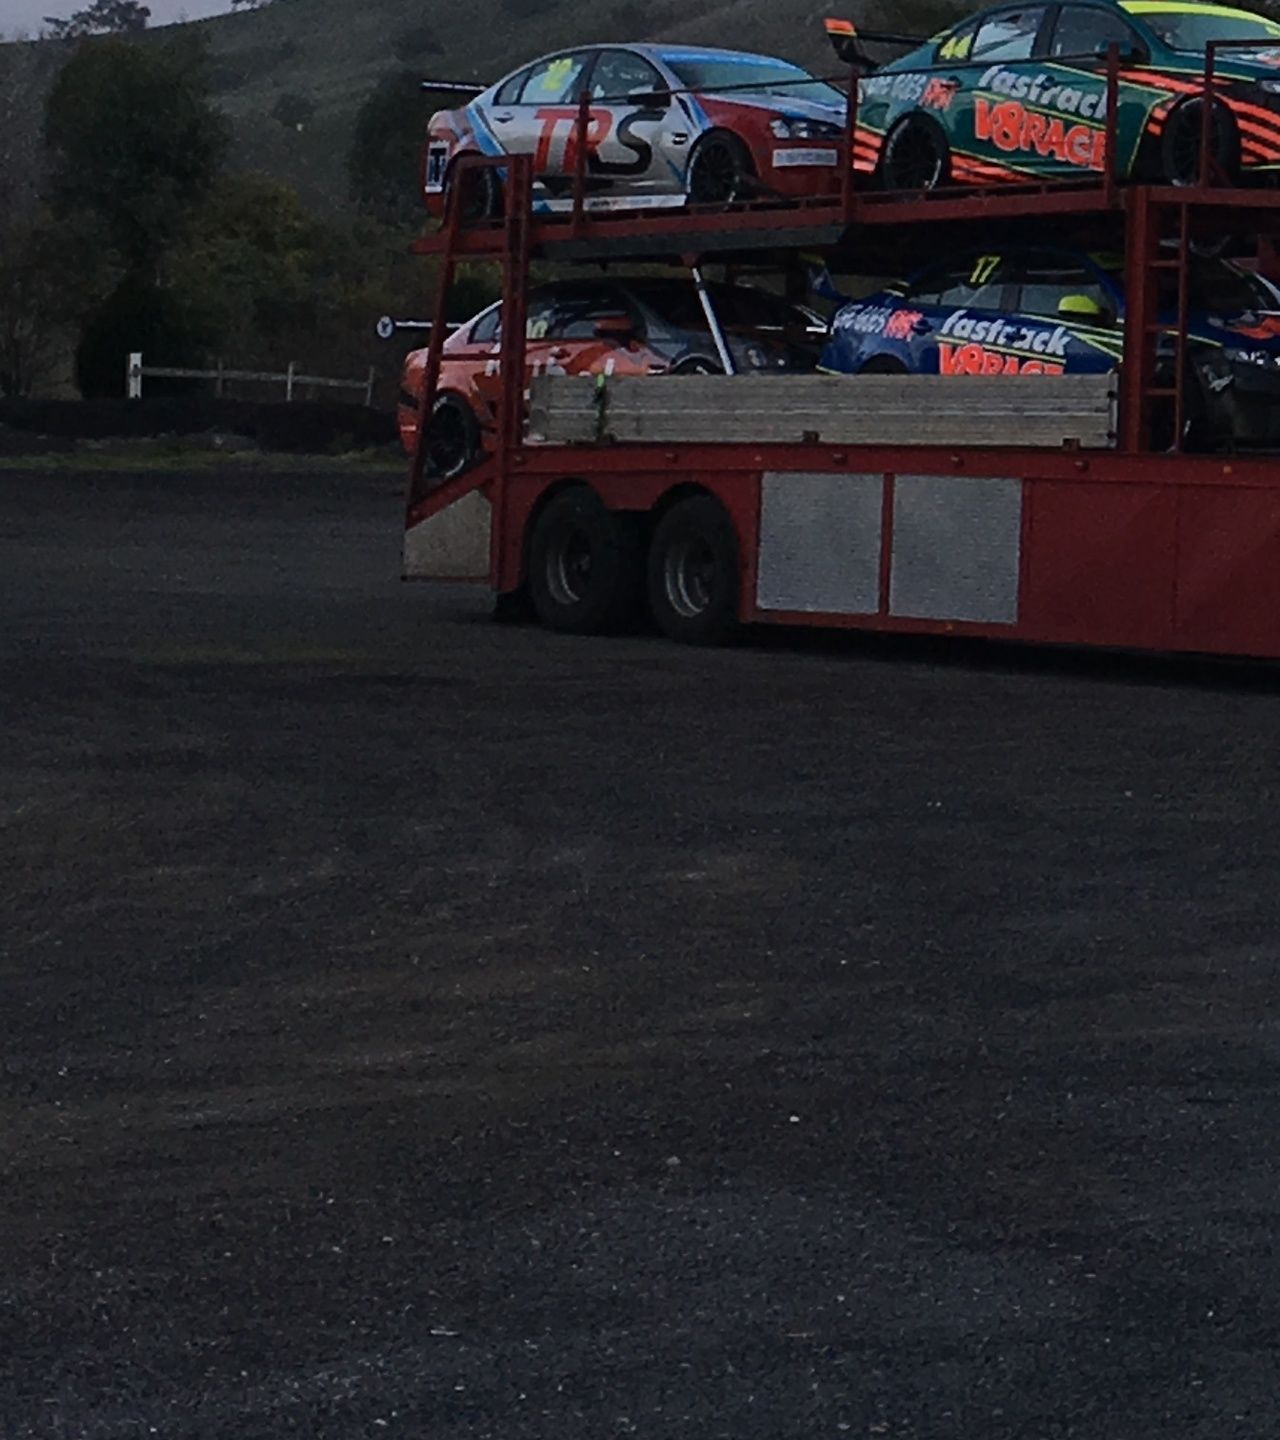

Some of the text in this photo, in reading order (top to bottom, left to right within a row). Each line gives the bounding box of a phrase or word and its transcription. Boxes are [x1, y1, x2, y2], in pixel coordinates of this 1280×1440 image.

[534, 108, 666, 174] TRS
[970, 255, 1003, 285] 17
[941, 309, 1073, 357] fastrack
